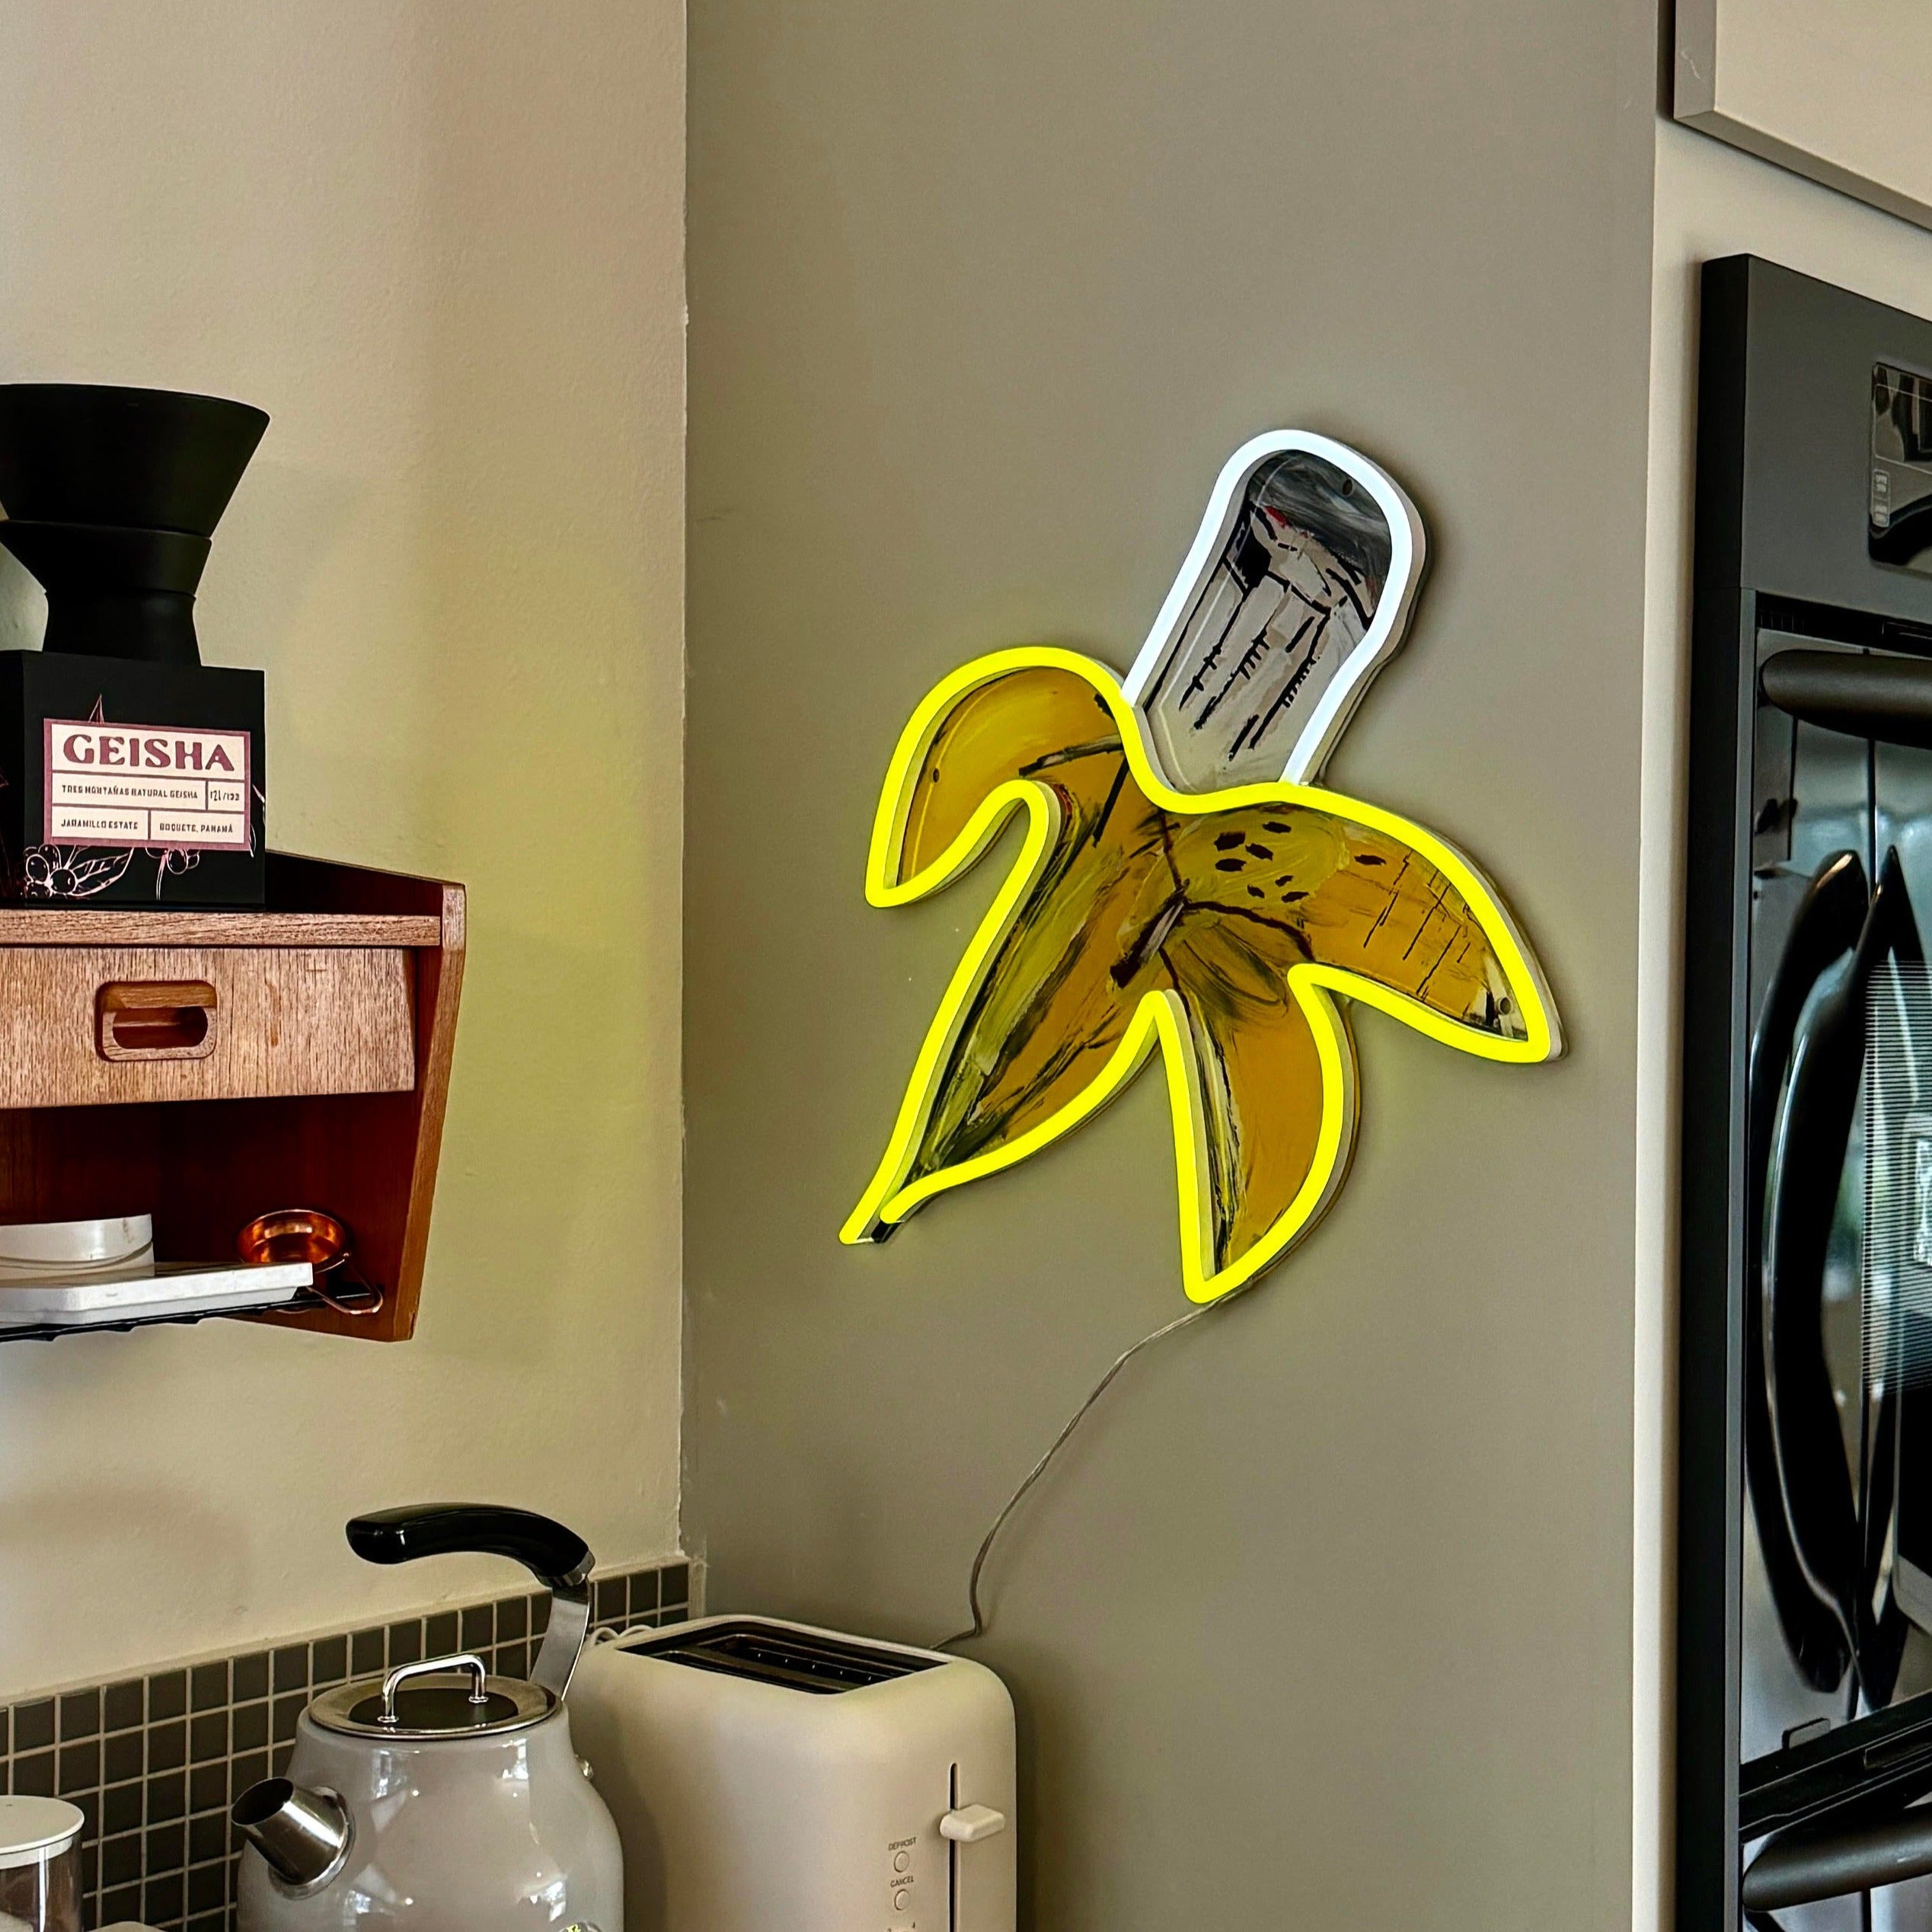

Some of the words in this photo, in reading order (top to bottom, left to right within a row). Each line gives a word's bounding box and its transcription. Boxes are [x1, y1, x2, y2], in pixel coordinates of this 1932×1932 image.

[63, 734, 235, 771] GEISHA
[62, 784, 83, 794] TRES
[85, 784, 129, 796] MONTAÑAS
[131, 788, 168, 798] NATURAL
[170, 790, 198, 799] GEISHA
[61, 819, 107, 829] JARAMILLO
[108, 820, 139, 830] ESTATE
[159, 822, 199, 833] BOQUETE,
[888, 1837, 917, 1851] DEFROST
[890, 1876, 914, 1888] CANCEL
